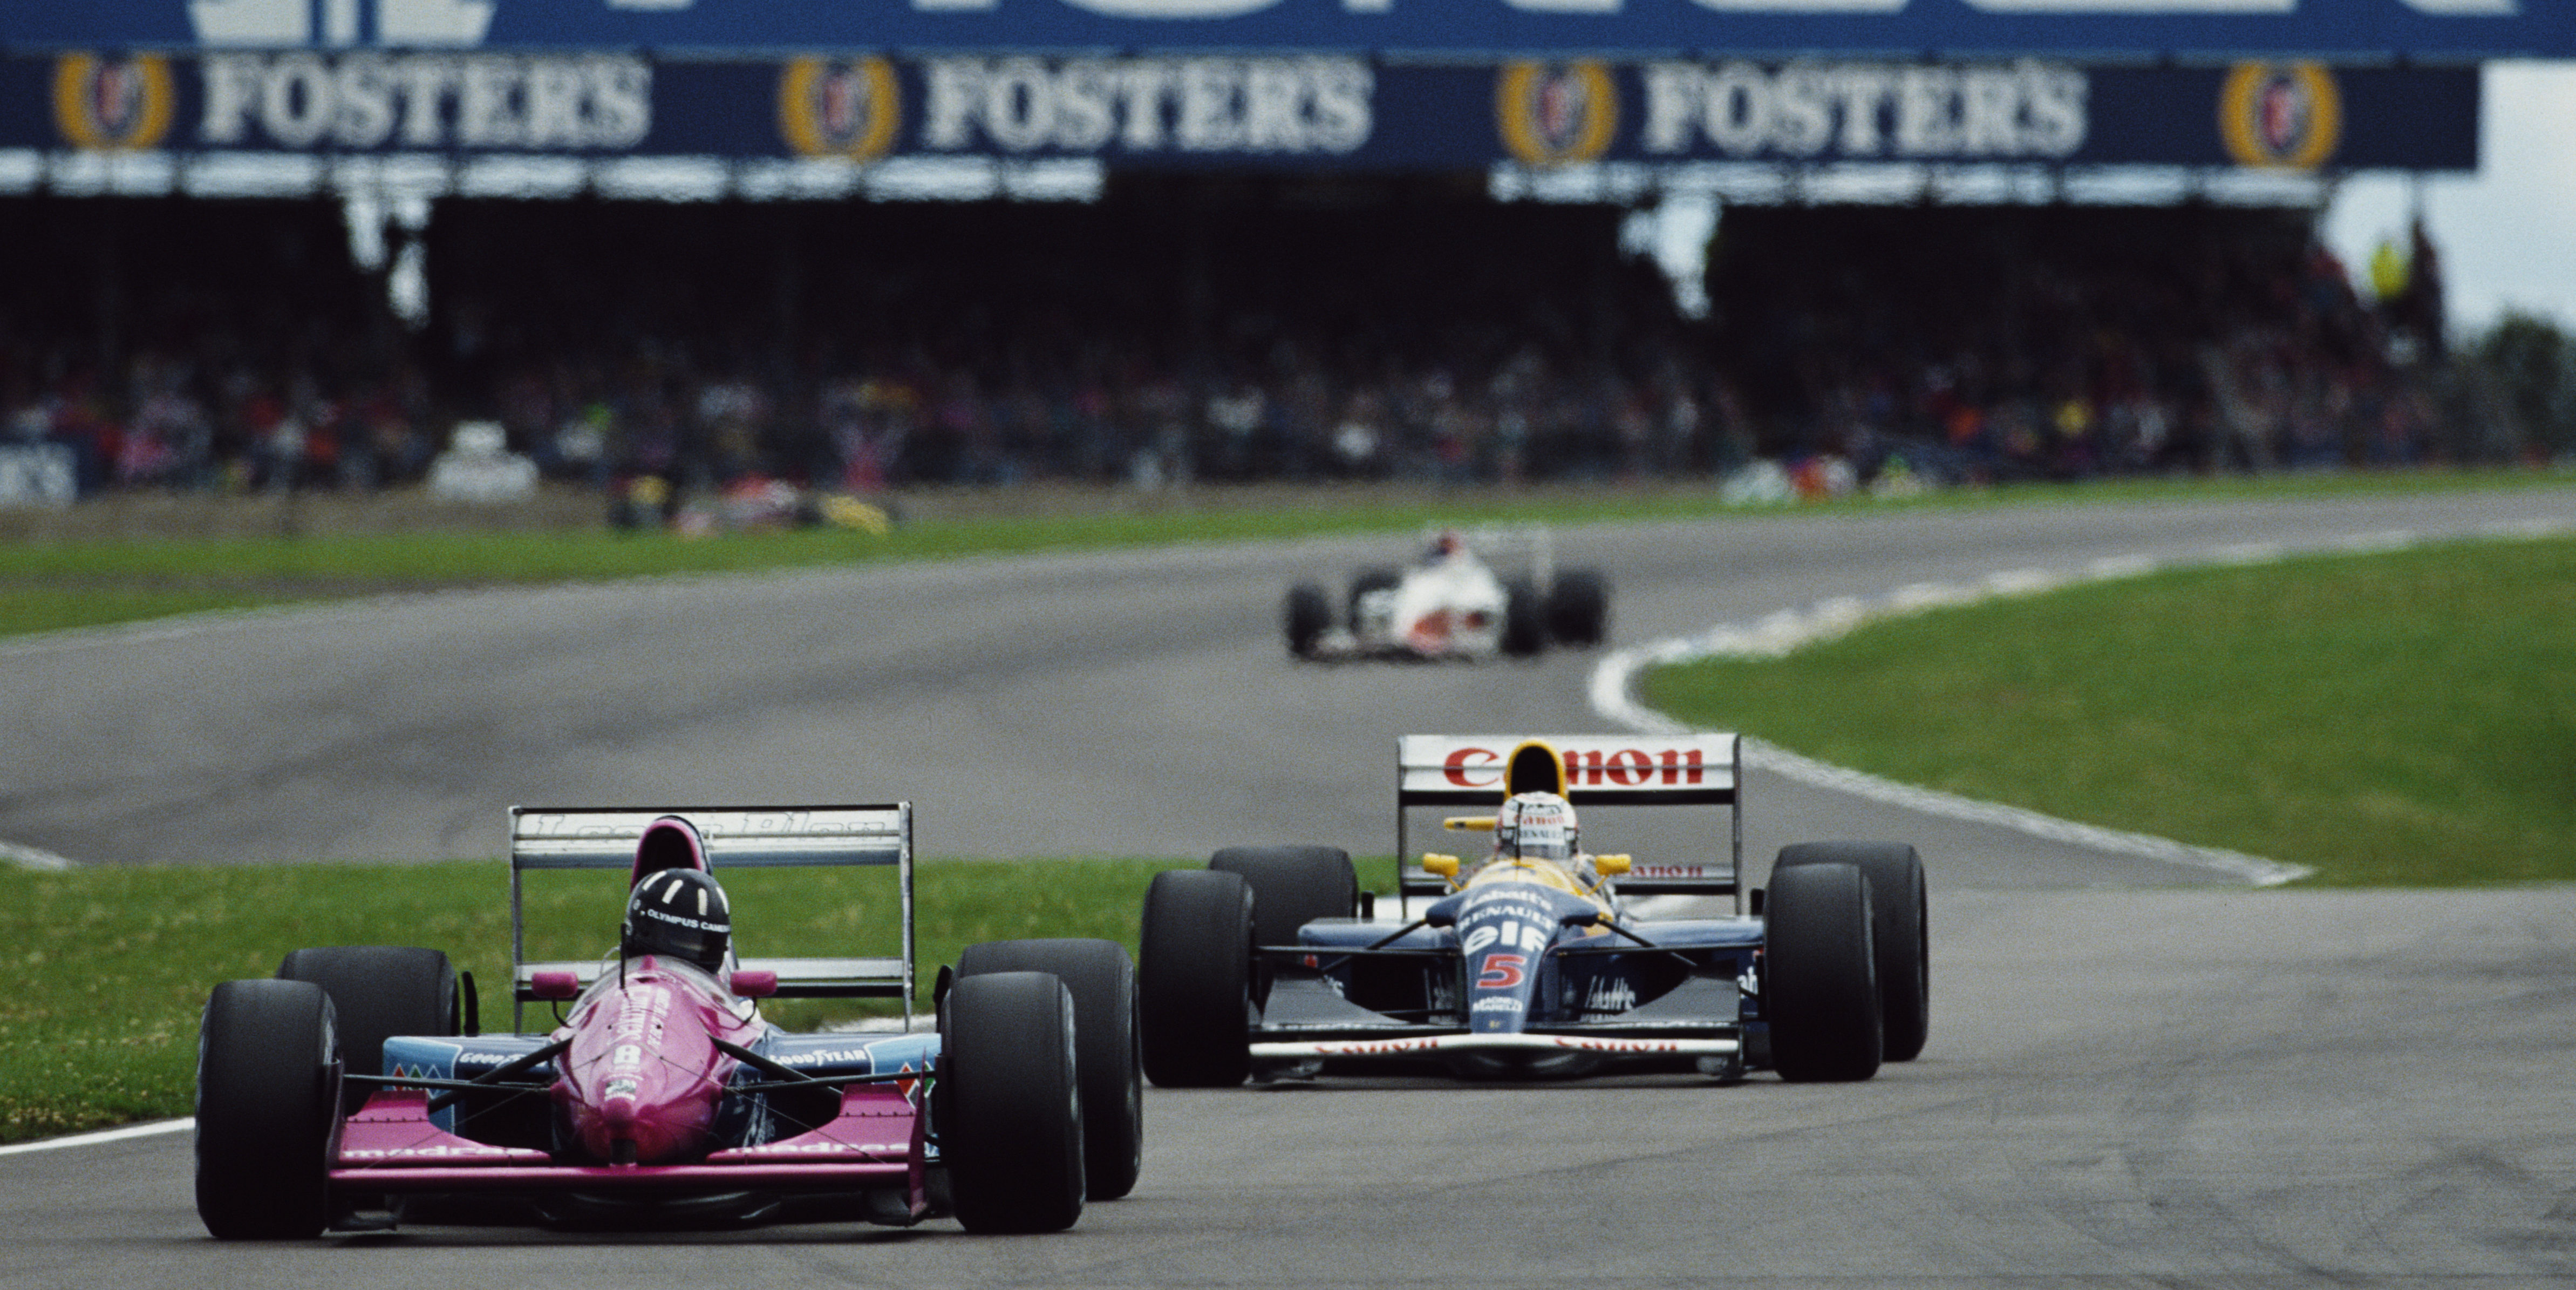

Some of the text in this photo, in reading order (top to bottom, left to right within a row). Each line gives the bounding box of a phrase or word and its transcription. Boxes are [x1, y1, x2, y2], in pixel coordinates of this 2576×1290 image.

[1443, 748, 1702, 787] Cnon
[1630, 865, 1702, 877] anon
[647, 908, 699, 929] OLYMPUS
[1475, 953, 1528, 989] 5
